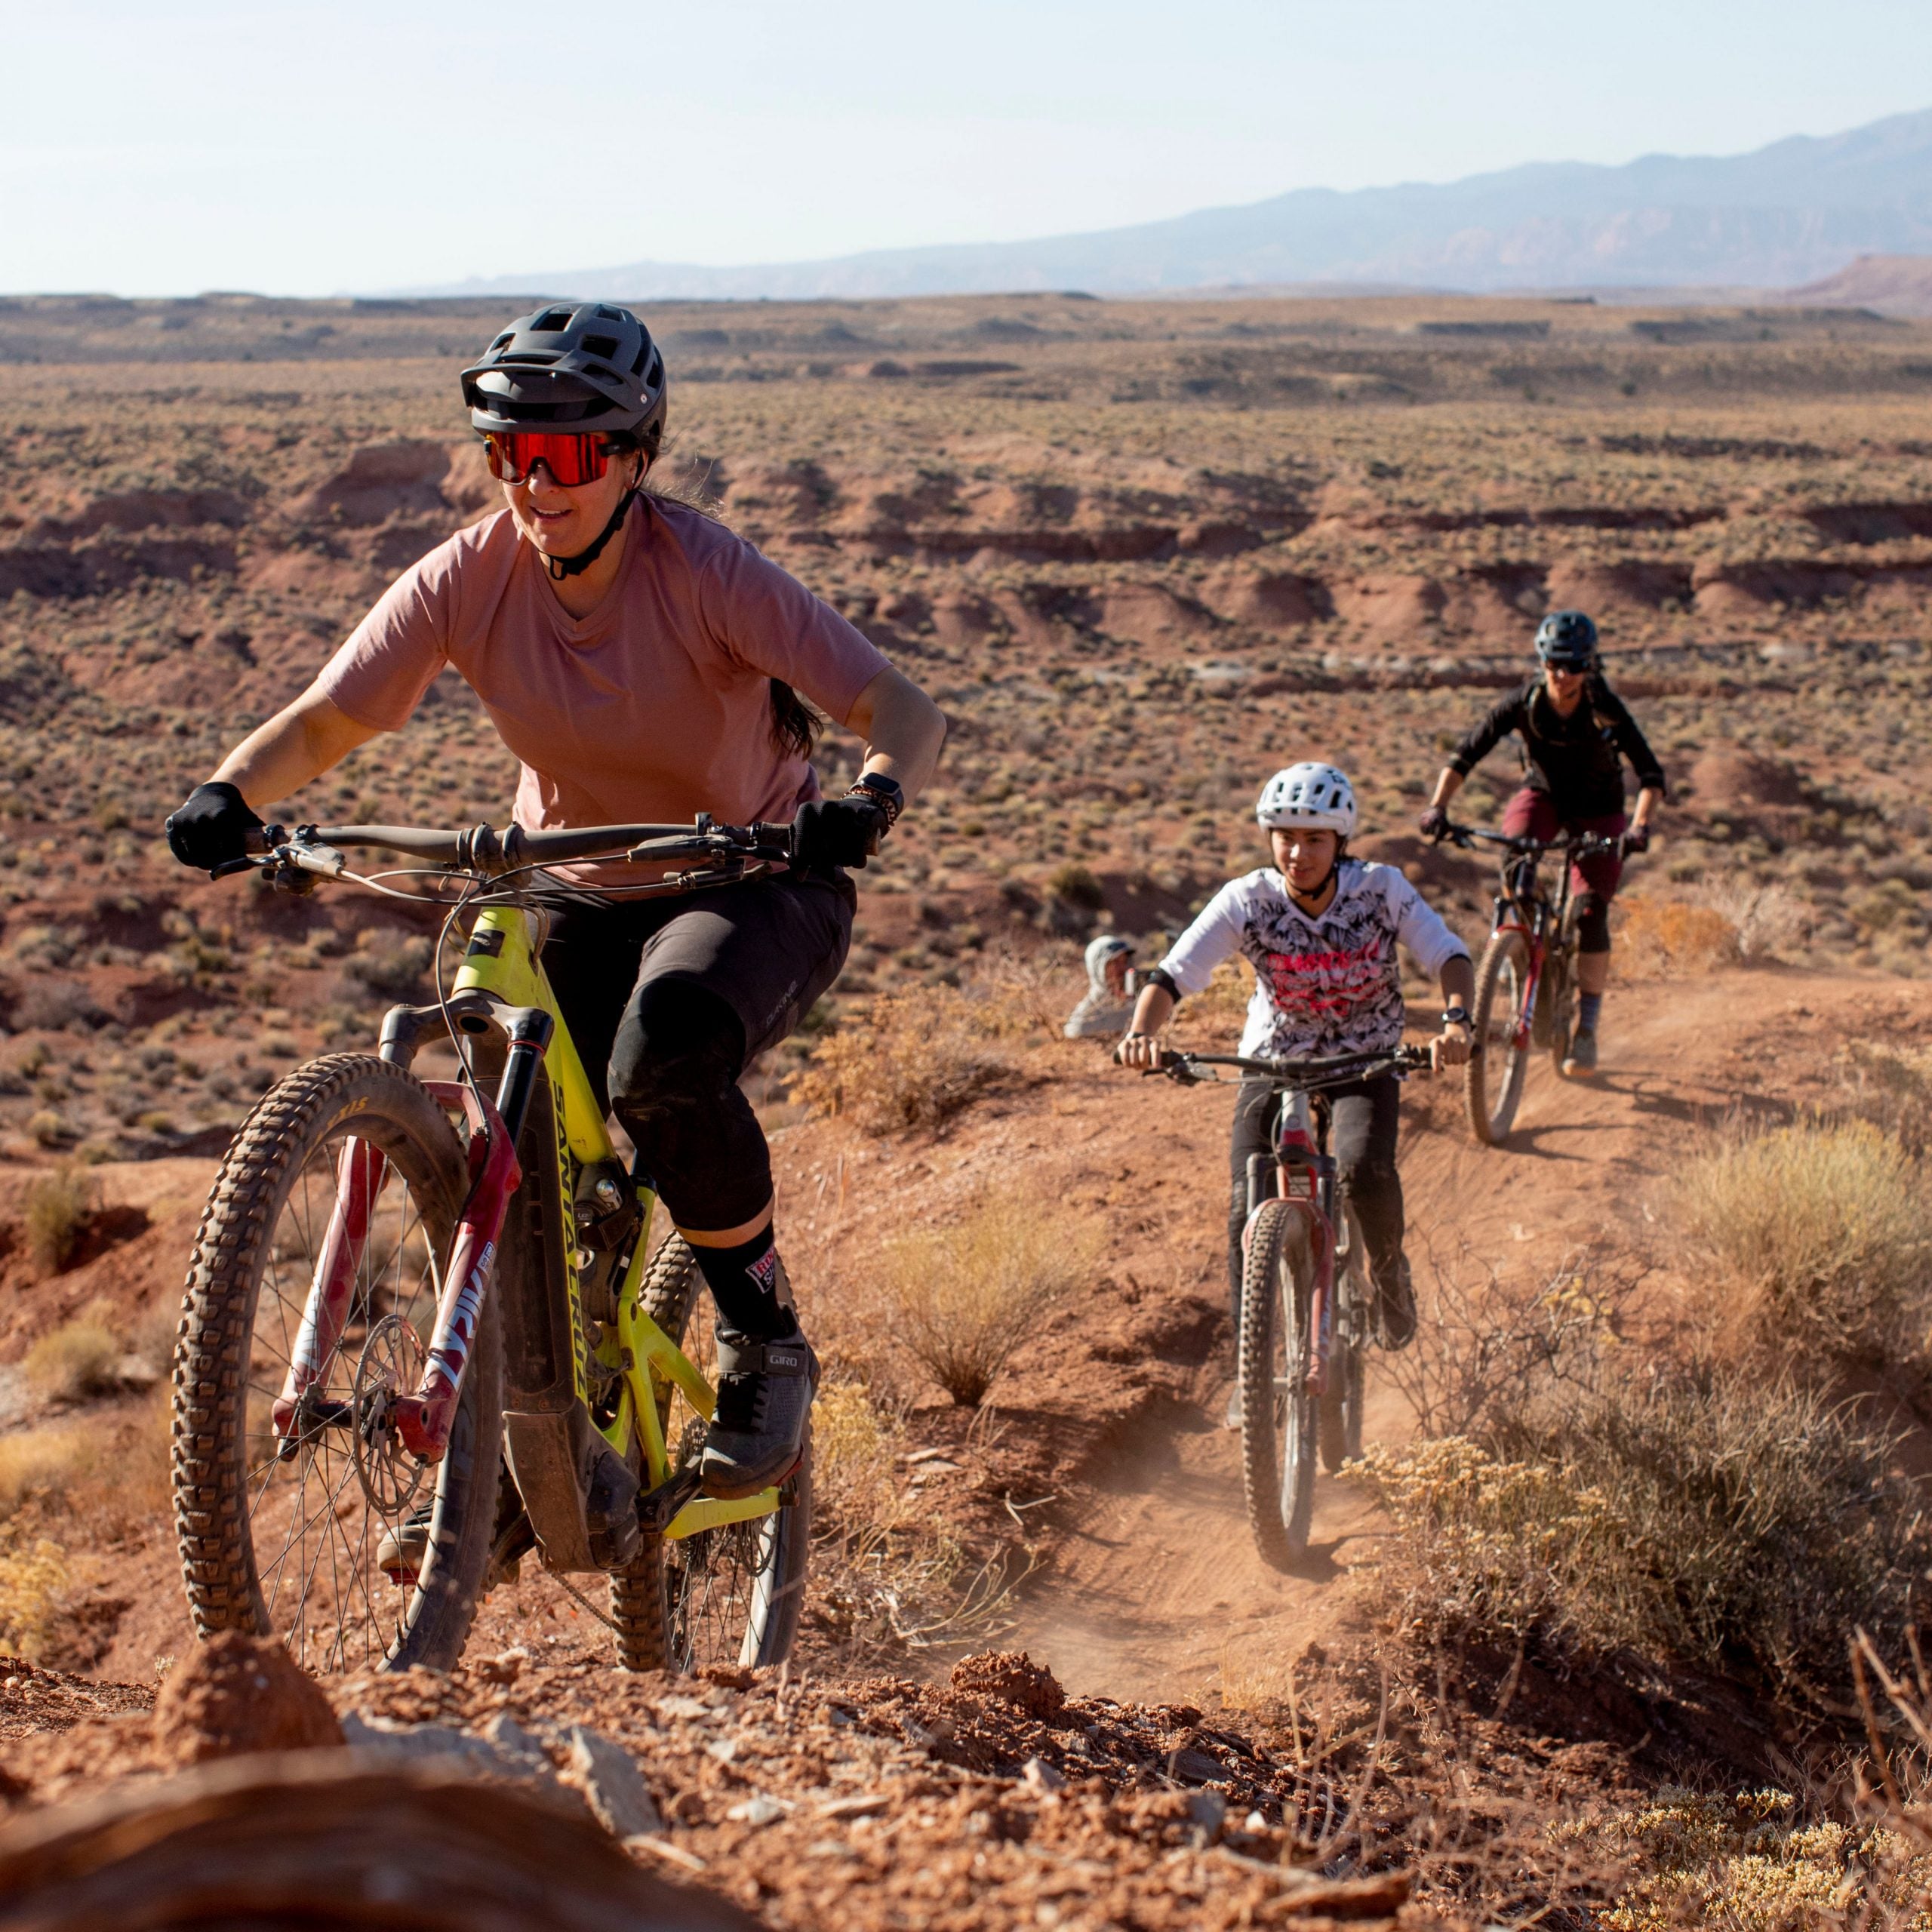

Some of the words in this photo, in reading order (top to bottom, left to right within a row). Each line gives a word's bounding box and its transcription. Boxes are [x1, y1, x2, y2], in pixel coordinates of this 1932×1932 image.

[553, 1080, 574, 1254] SANTA
[568, 1263, 586, 1394] CRUZ
[770, 1355, 798, 1367] GIRO
